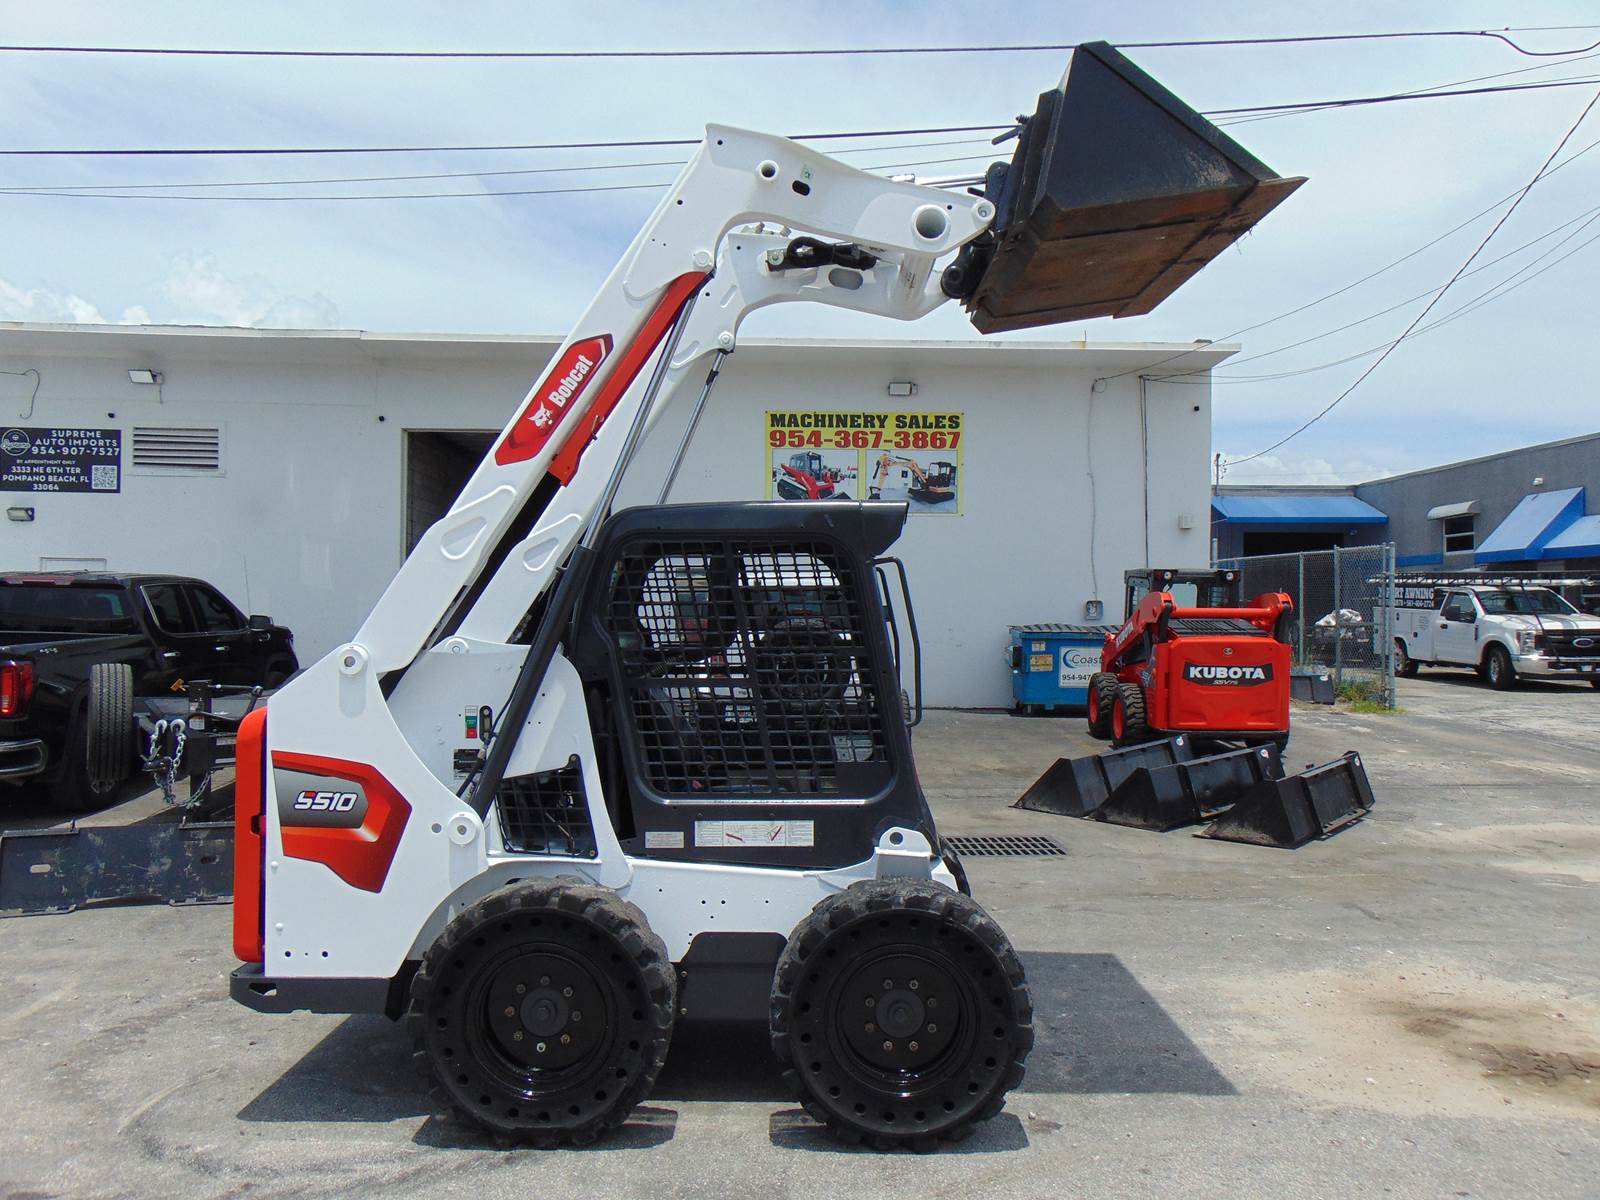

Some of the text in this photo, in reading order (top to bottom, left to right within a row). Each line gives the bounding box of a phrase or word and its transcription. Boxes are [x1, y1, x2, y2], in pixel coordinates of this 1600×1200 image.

[548, 354, 594, 408] Bobcat
[770, 413, 961, 430] MACHINERY SALES
[51, 430, 102, 438] SUPREME
[769, 429, 961, 449] 954-367-3867
[35, 438, 66, 446] AUTO
[69, 439, 118, 447] IMPORTS
[31, 446, 120, 456] 954-907-7527
[11, 465, 31, 473] 3333
[46, 466, 65, 474] 6TH
[2, 474, 46, 482] POMPANO
[48, 475, 78, 483] BEACH,
[32, 483, 60, 491] 33064
[1404, 587, 1434, 600] AWNING
[1189, 666, 1266, 679] KUBOTA
[294, 791, 358, 811] S510
